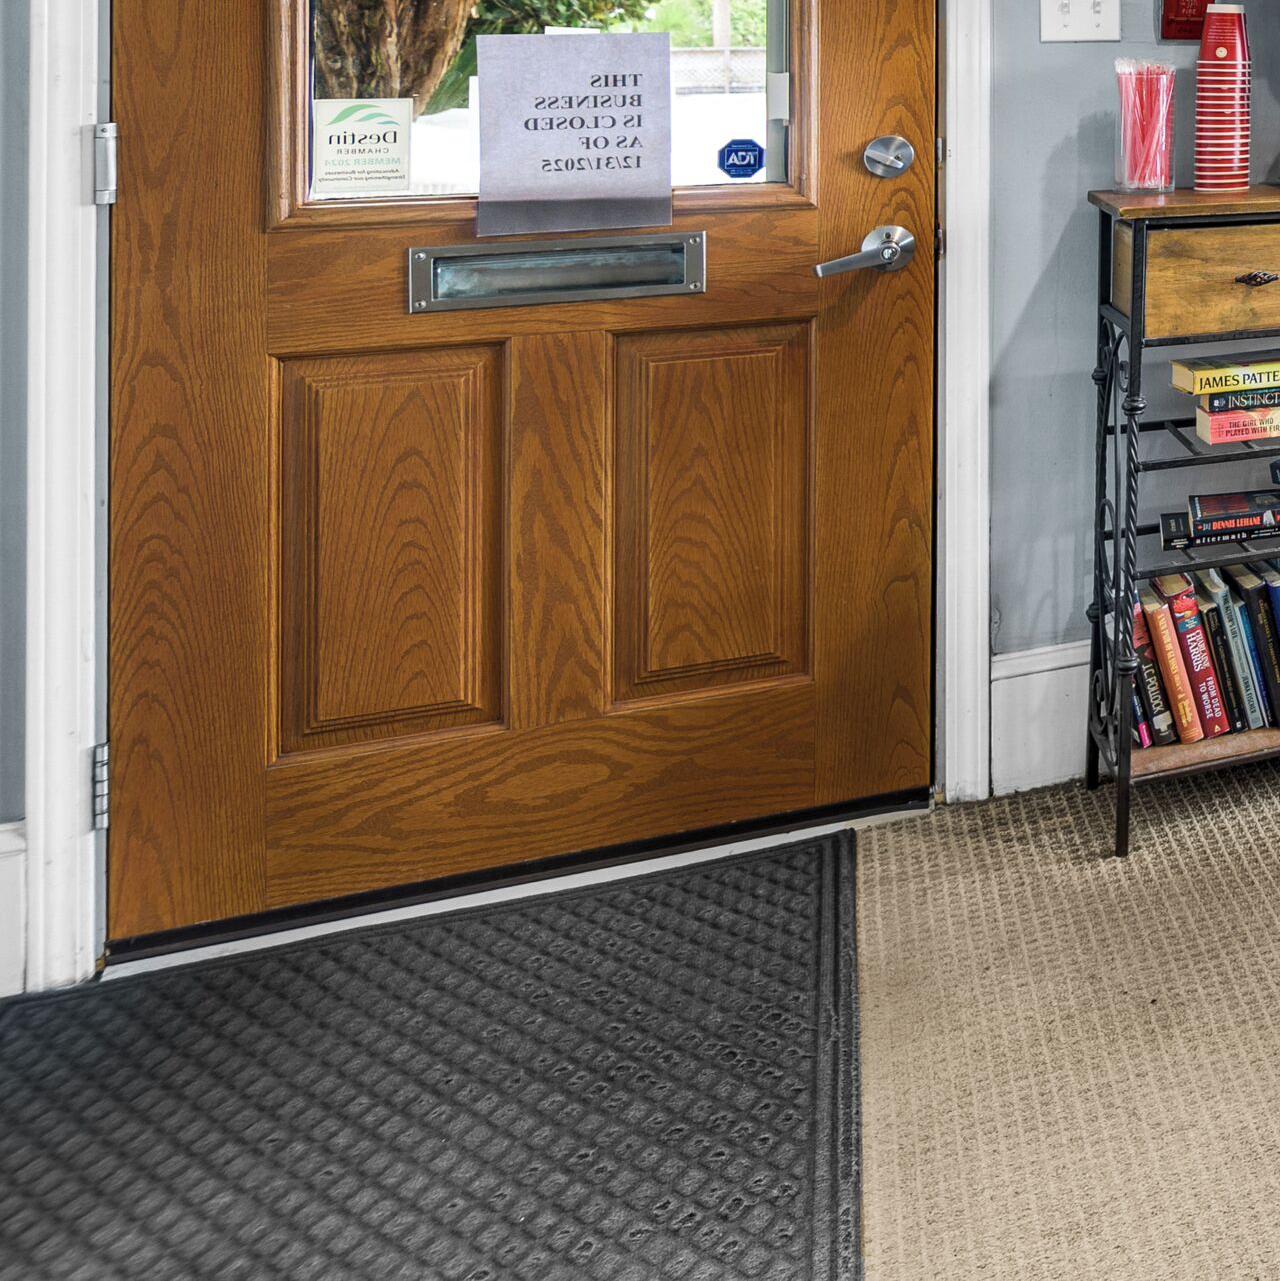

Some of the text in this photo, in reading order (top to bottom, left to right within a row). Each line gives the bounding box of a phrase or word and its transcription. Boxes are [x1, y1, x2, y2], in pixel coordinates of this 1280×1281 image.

[727, 152, 758, 165] ADT
[1200, 375, 1239, 391] JAMES
[1228, 392, 1280, 408] INSTINCT
[1226, 428, 1250, 436] PLAYED
[1251, 425, 1268, 434] WITH
[1229, 417, 1274, 429] THE GIRL WHO
[1212, 516, 1261, 530] DENNIS LEHANE
[1196, 532, 1247, 544] aftermath
[1185, 632, 1204, 672] HARRIS
[1194, 629, 1210, 668] CHARLAINE
[1221, 594, 1256, 714] THE ACTOR'S LIFE JENNA FISCHER
[1141, 662, 1155, 678] J.C.
[1144, 676, 1164, 714] POLLOCK
[1198, 682, 1213, 719] TO WORSE
[1205, 676, 1222, 718] FROM DEAD
